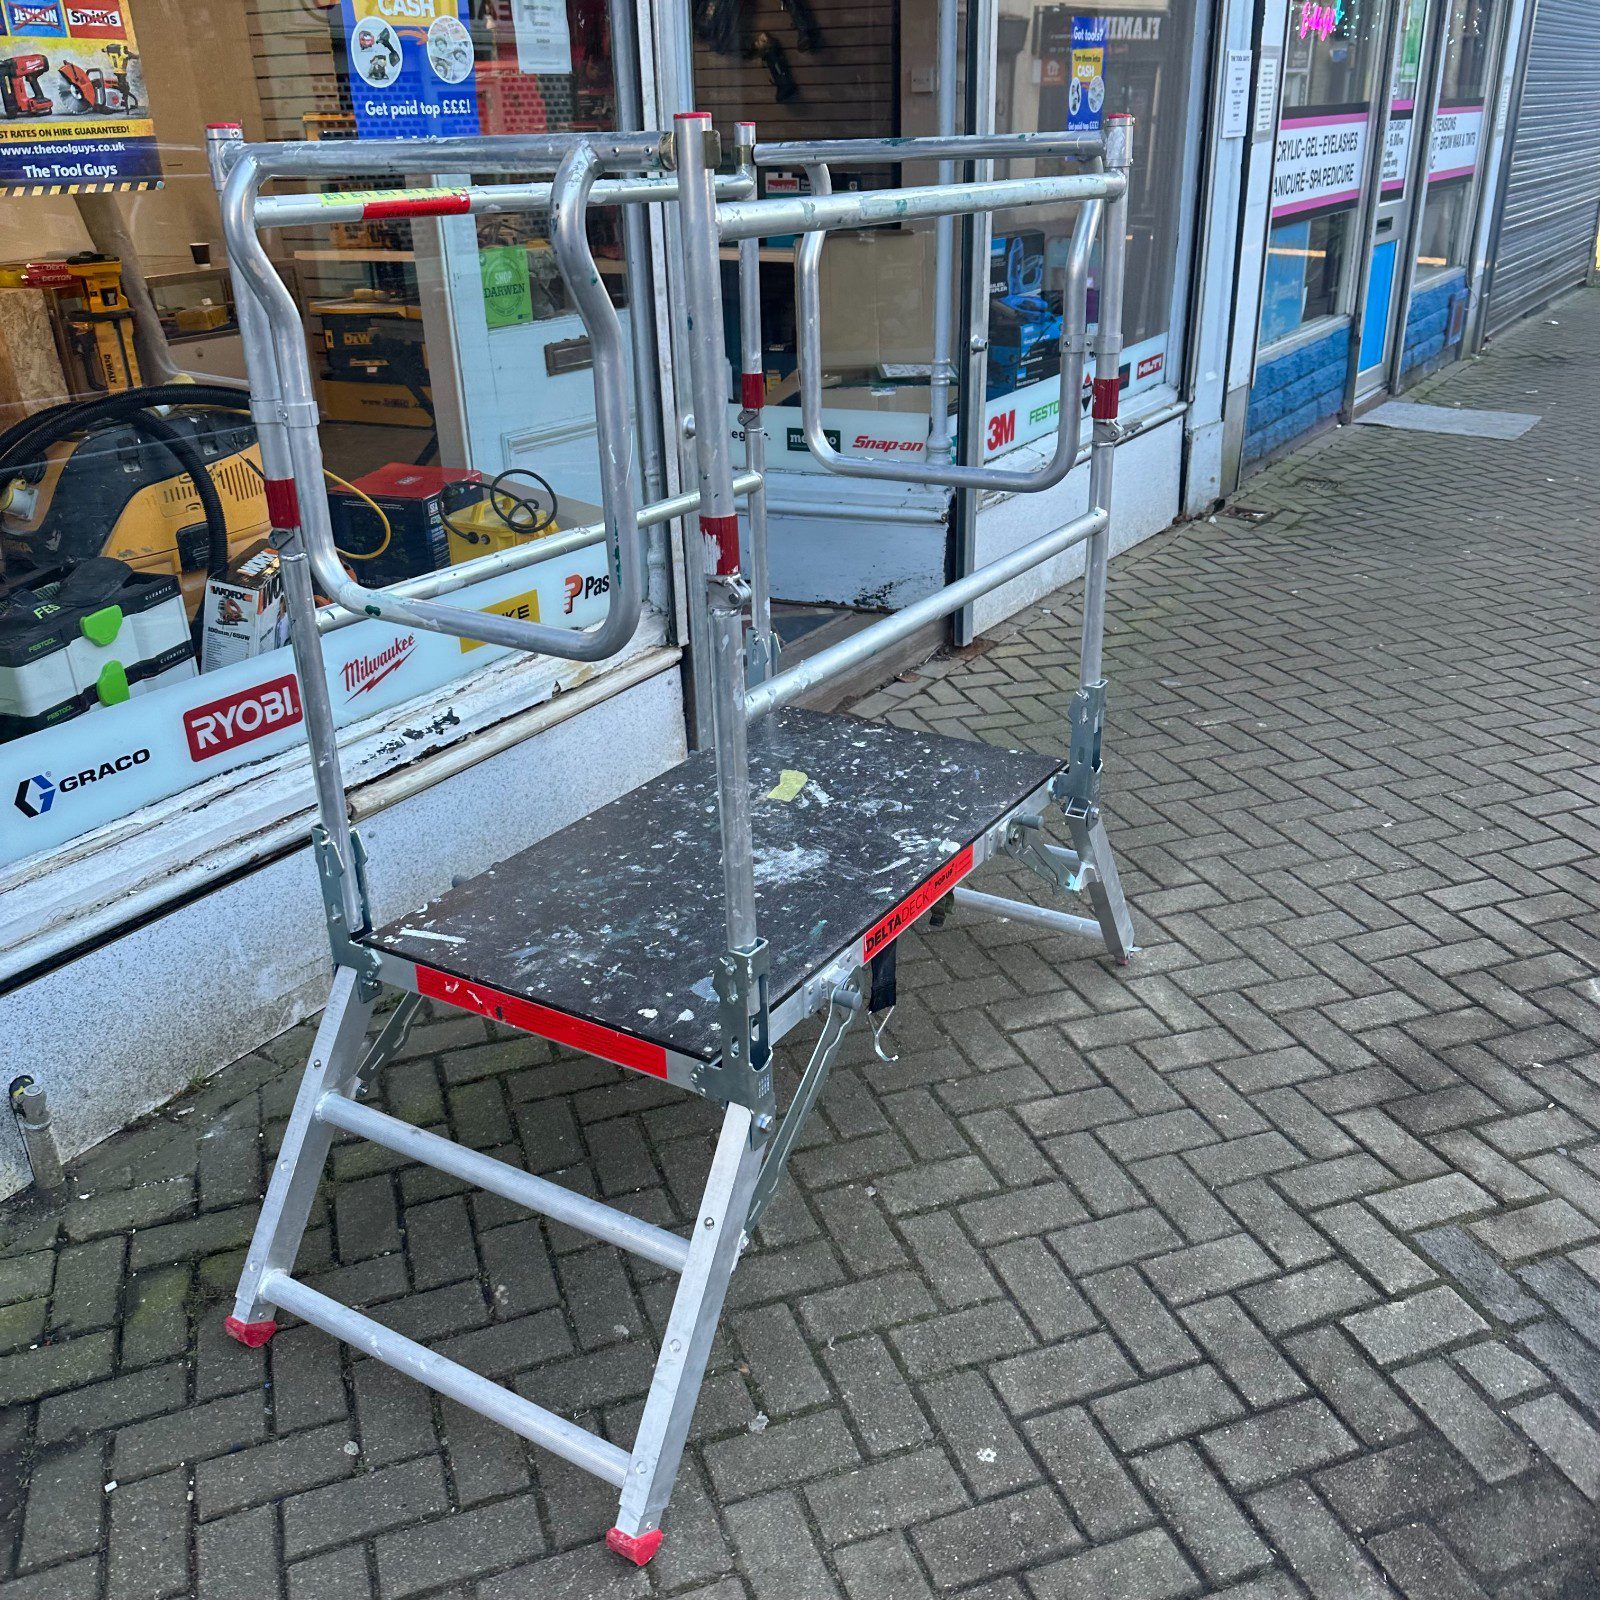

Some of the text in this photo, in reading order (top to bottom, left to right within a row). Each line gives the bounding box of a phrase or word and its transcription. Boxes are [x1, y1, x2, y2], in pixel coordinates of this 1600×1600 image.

[378, 0, 436, 18] CASH
[1073, 26, 1104, 41] Got tools?
[1077, 65, 1095, 77] CASH
[365, 99, 470, 120] Get paid top £££!
[10, 129, 37, 138] RATES
[38, 128, 52, 137] ON
[54, 128, 73, 136] HIRE
[75, 126, 130, 136] GUARANTEED!
[0, 142, 126, 156] www.thetoolguys.co.uk
[22, 164, 118, 178] The Tool Guys
[494, 270, 512, 285] SHOP
[484, 283, 525, 298] DARWEN
[1030, 400, 1060, 426] FESTO
[987, 410, 1015, 451] 3M
[852, 436, 924, 452] Snap-on
[145, 585, 172, 600] CLEANTEC
[585, 575, 610, 600] Pas
[29, 637, 57, 652] FESTOOL
[340, 634, 414, 692] Milwaukee
[47, 704, 74, 721] FESTOOL
[192, 686, 294, 750] RYOBI
[59, 748, 150, 793] GRACO
[866, 890, 929, 954] DELTADECK
